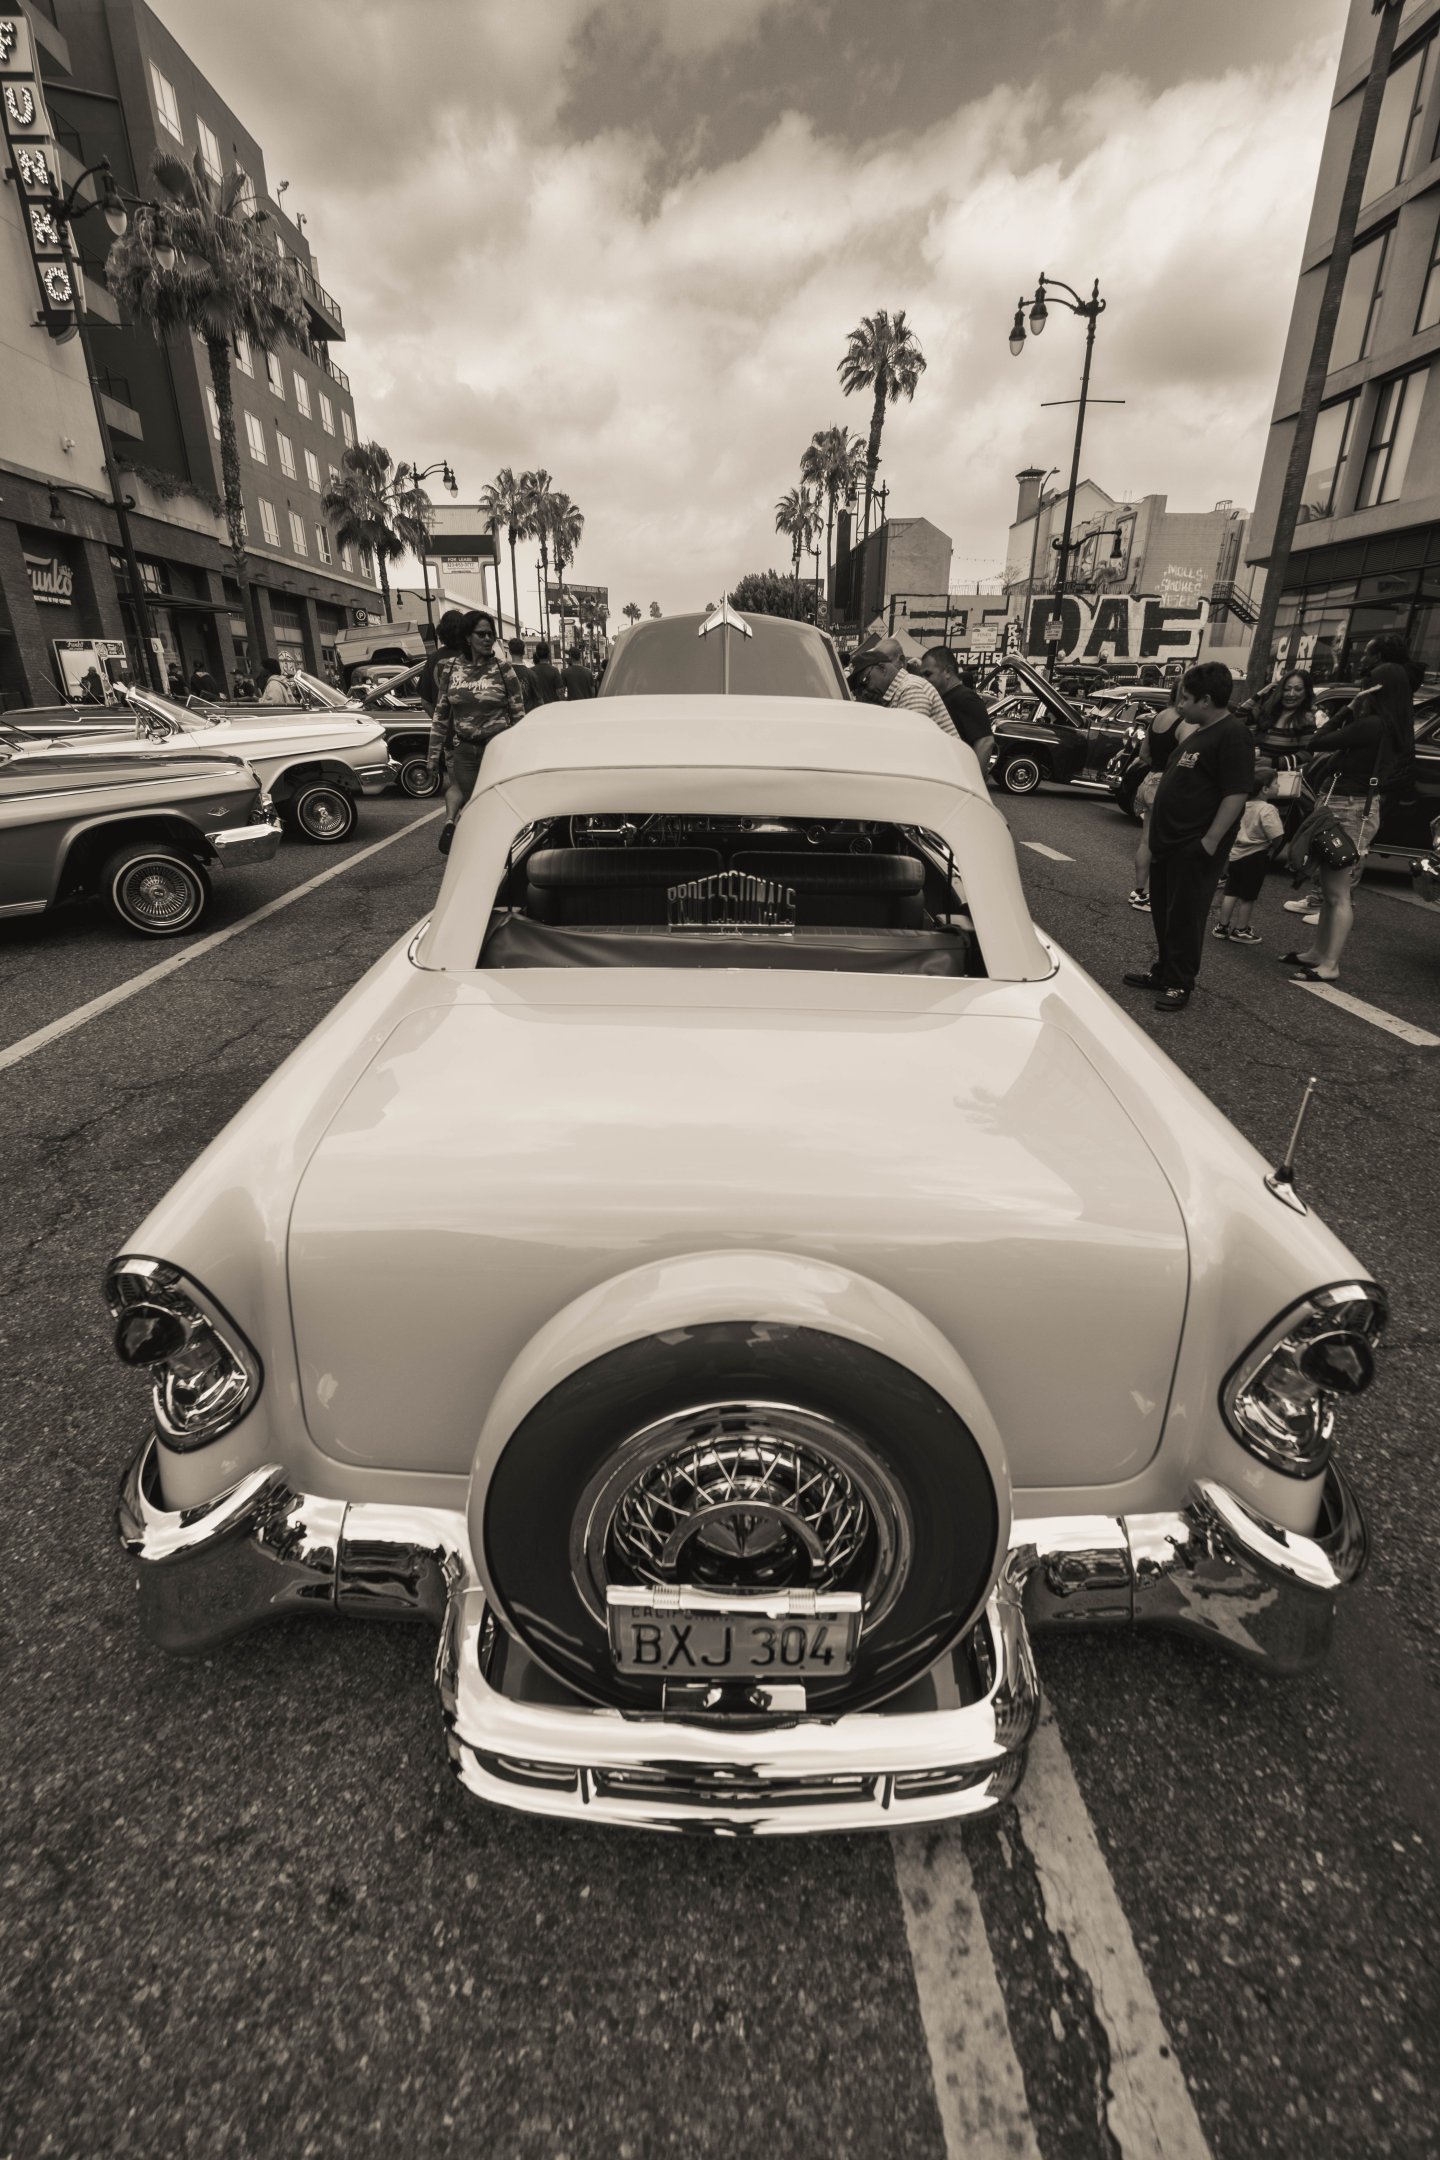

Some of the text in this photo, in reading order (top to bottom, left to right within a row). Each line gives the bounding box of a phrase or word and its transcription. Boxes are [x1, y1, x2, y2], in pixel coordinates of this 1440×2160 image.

[953, 652, 1004, 666] AZIER
[631, 1623, 835, 1667] BXJ 304
